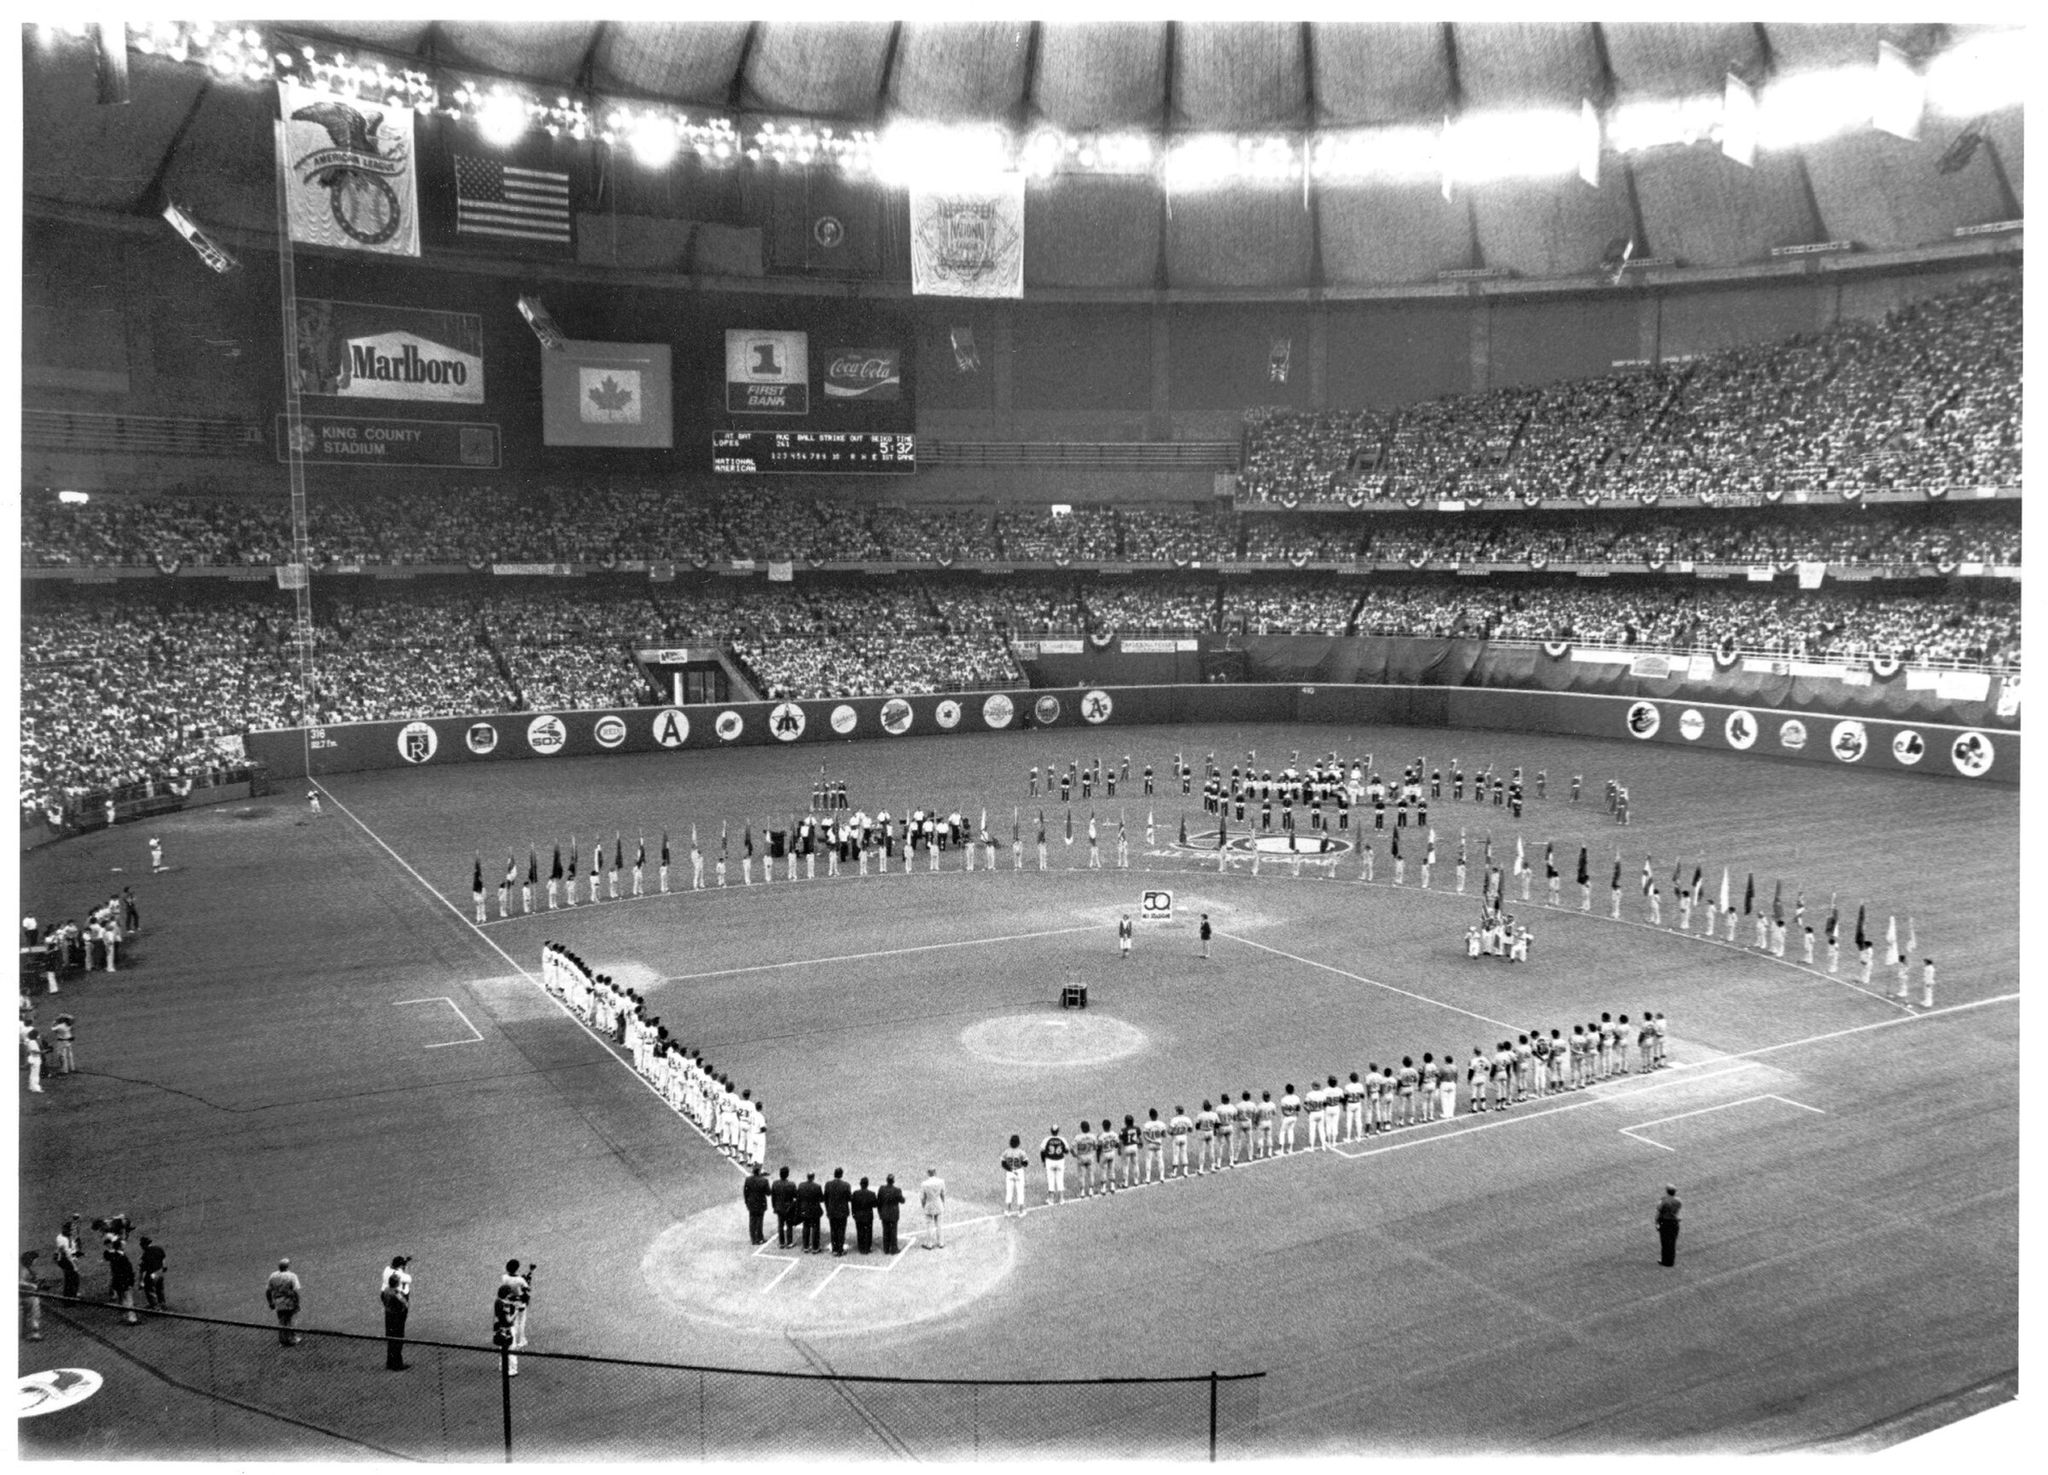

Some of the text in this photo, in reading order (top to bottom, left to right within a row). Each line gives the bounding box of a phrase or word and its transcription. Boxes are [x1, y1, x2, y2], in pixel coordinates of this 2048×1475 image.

[313, 153, 396, 172] AMERICAN LEAGUE
[352, 343, 467, 386] Marlboro
[752, 344, 782, 375] 1
[746, 385, 788, 396] FIRST
[748, 395, 786, 406] BANK
[322, 426, 422, 442] KING COUNTY
[797, 434, 815, 442] BALL
[819, 434, 846, 442] STRIKE
[896, 435, 913, 443] TIME
[323, 441, 386, 456] STADIUM
[879, 442, 914, 454] 5:37
[714, 458, 756, 466] NATIONAL
[310, 728, 326, 739] 316
[531, 736, 563, 747] SOX
[1143, 891, 1171, 911] 50
